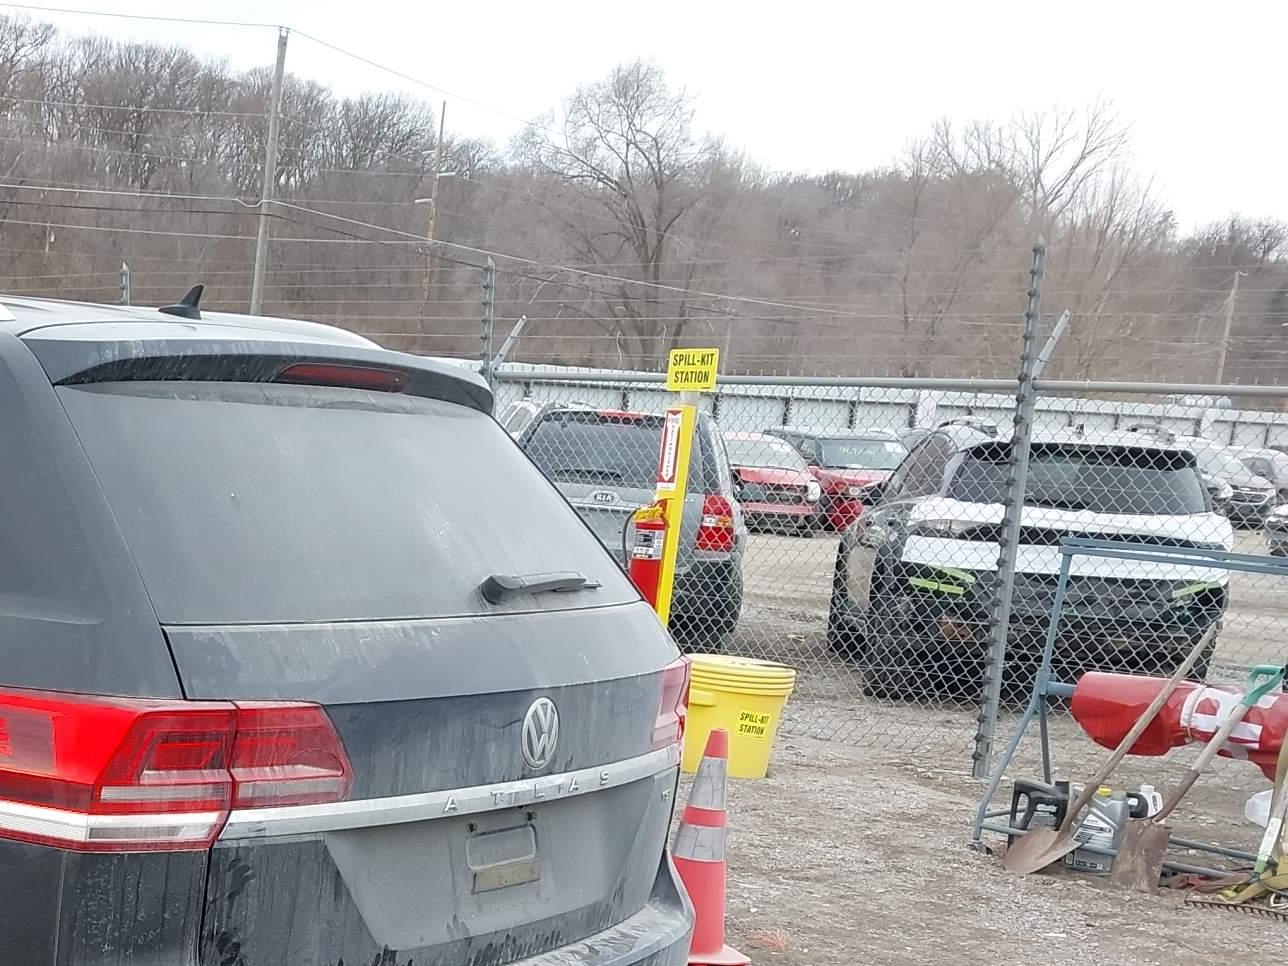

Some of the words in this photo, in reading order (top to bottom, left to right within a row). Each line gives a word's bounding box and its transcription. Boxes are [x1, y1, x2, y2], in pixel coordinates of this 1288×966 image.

[673, 353, 715, 366] SPILL-KIT
[674, 370, 710, 383] STATION
[596, 493, 613, 502] KIA
[740, 712, 769, 724] SPILL-KIT
[739, 724, 765, 735] STATION
[442, 770, 610, 813] ATLAS
